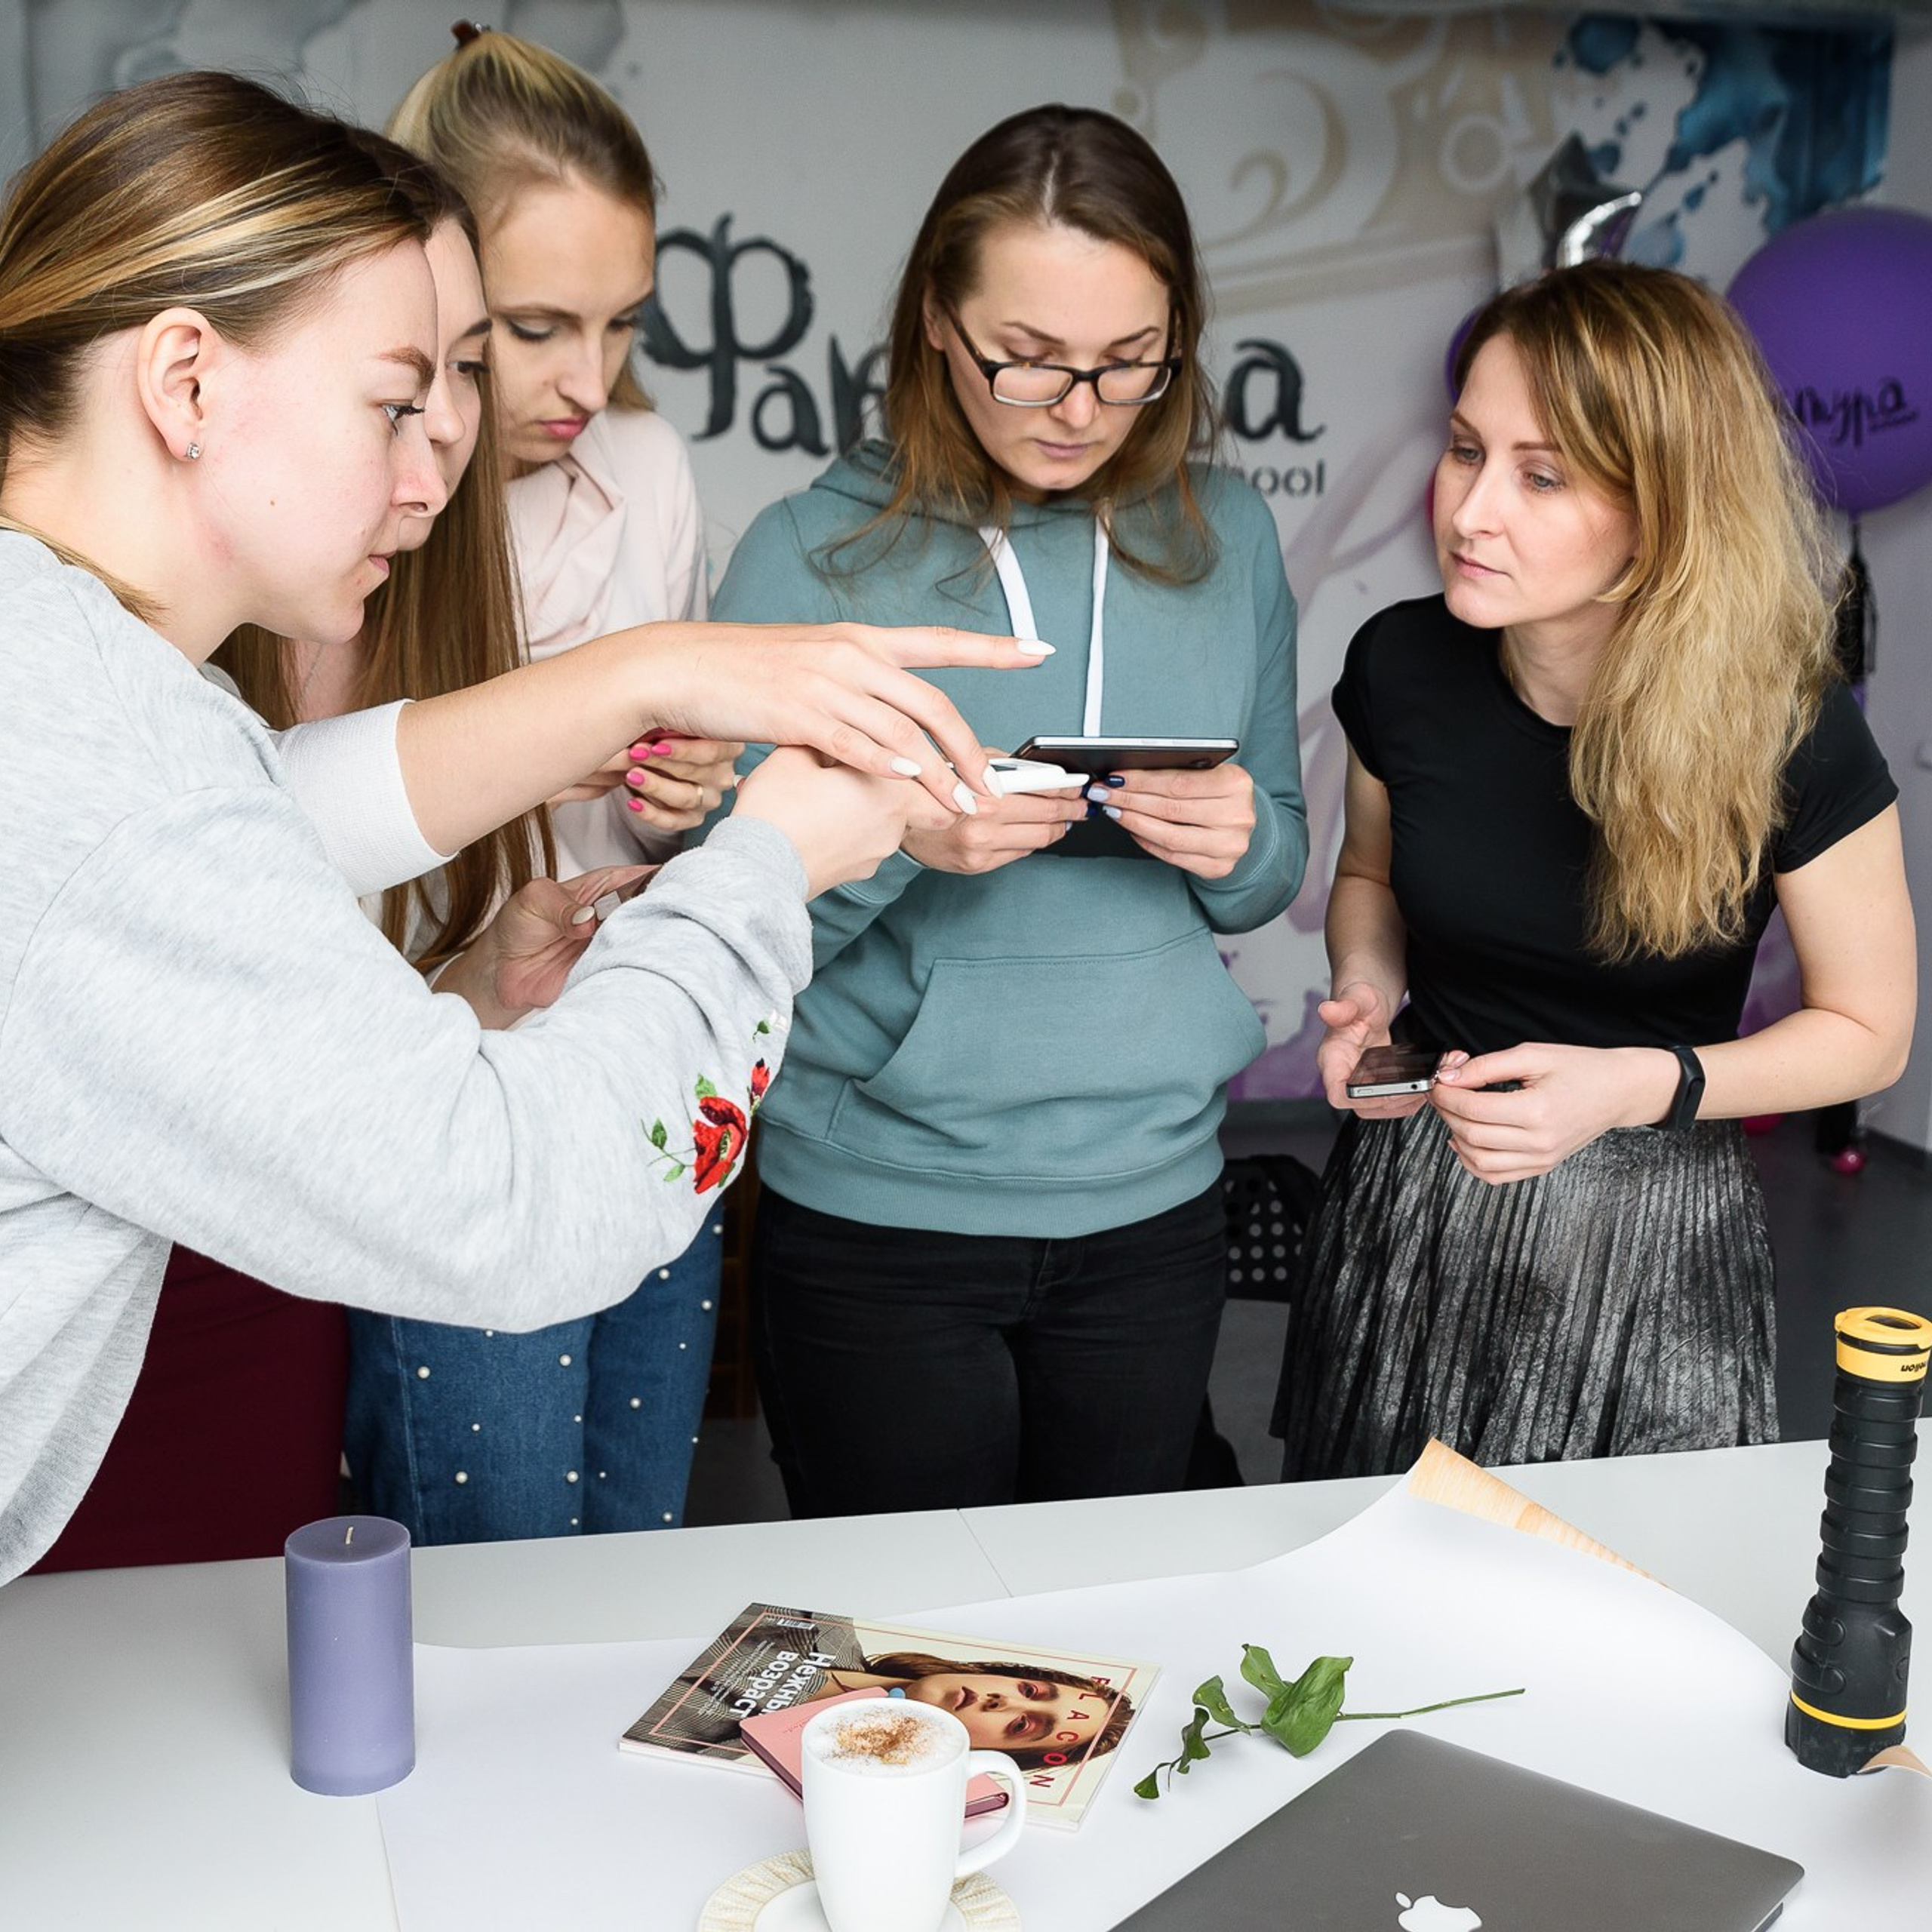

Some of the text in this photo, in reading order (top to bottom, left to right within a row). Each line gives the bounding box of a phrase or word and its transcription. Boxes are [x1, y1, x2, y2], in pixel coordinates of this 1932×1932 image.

[1251, 459, 1325, 497] ool
[758, 1651, 837, 1715] Нежны
[1029, 1675, 1111, 1788] FLACON
